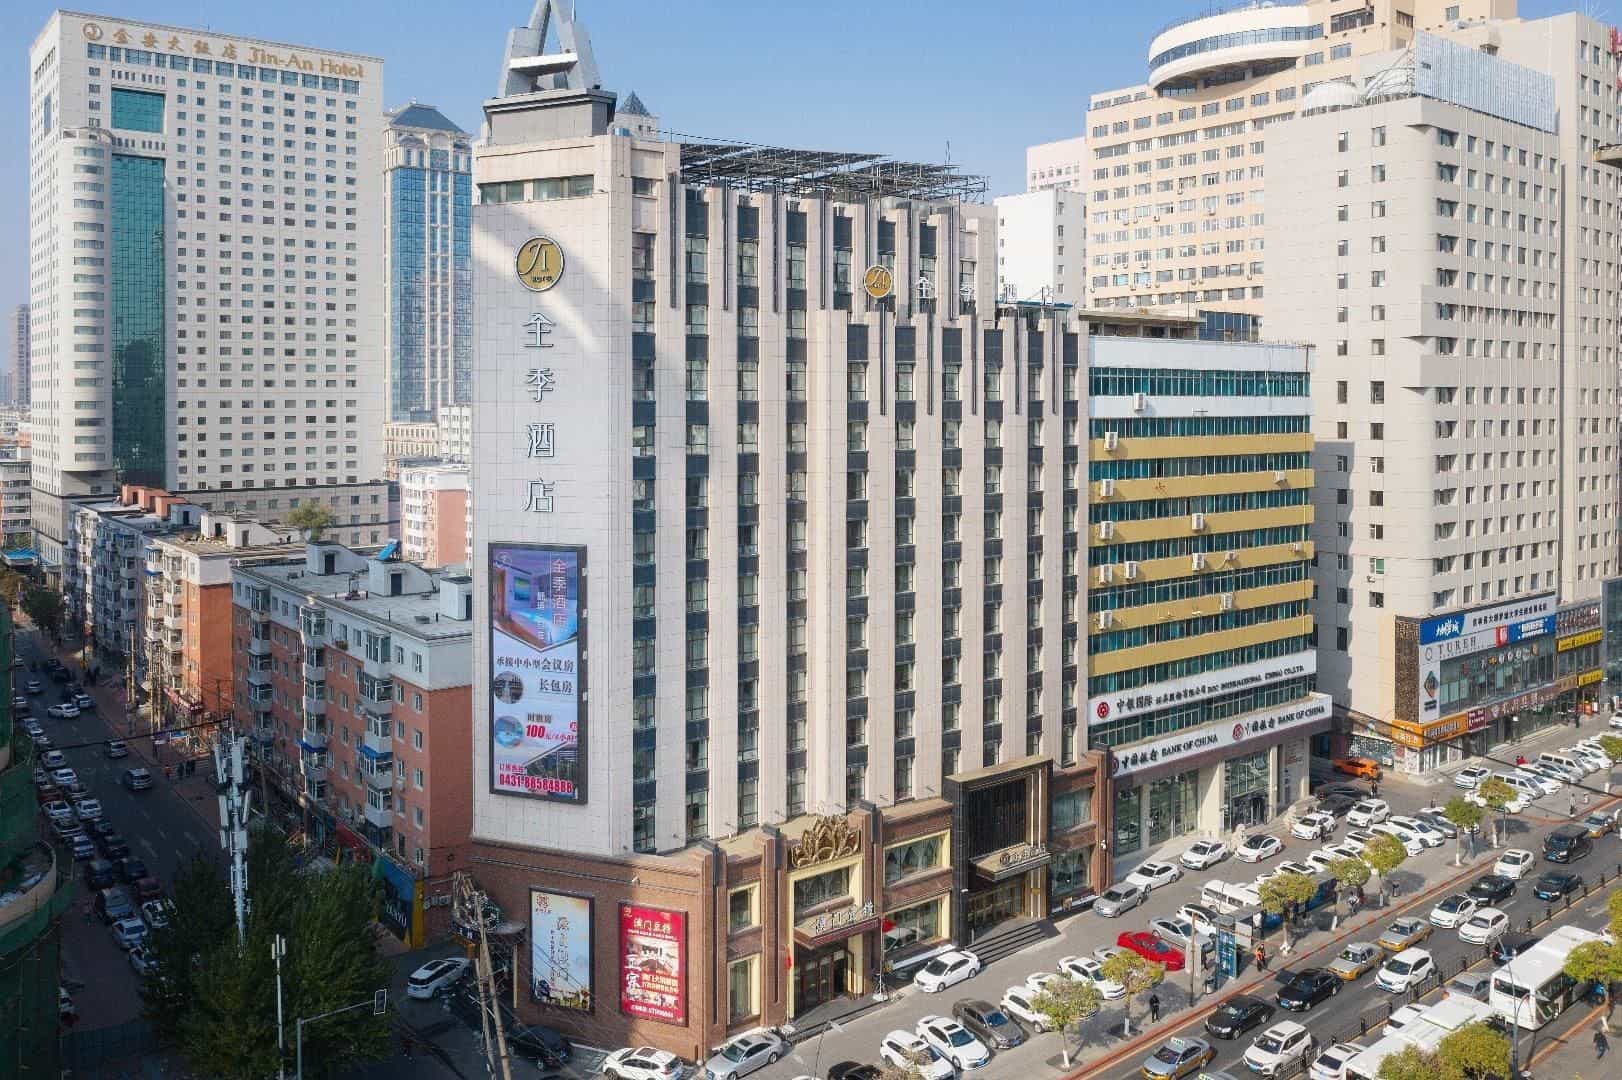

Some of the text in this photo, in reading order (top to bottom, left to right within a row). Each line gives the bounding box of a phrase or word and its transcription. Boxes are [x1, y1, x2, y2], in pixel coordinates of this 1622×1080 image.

[248, 46, 364, 78] Jin-An Hotel
[523, 312, 557, 513] 全季酒店
[551, 558, 568, 625] 全季酒店
[1117, 695, 1152, 714] 中银国际
[1243, 717, 1275, 735] 中国银行
[1277, 711, 1295, 726] BANK
[1304, 705, 1326, 719] CHINA
[526, 725, 545, 738] 100
[1121, 733, 1219, 769] 中国银行 BANK OF CHINA
